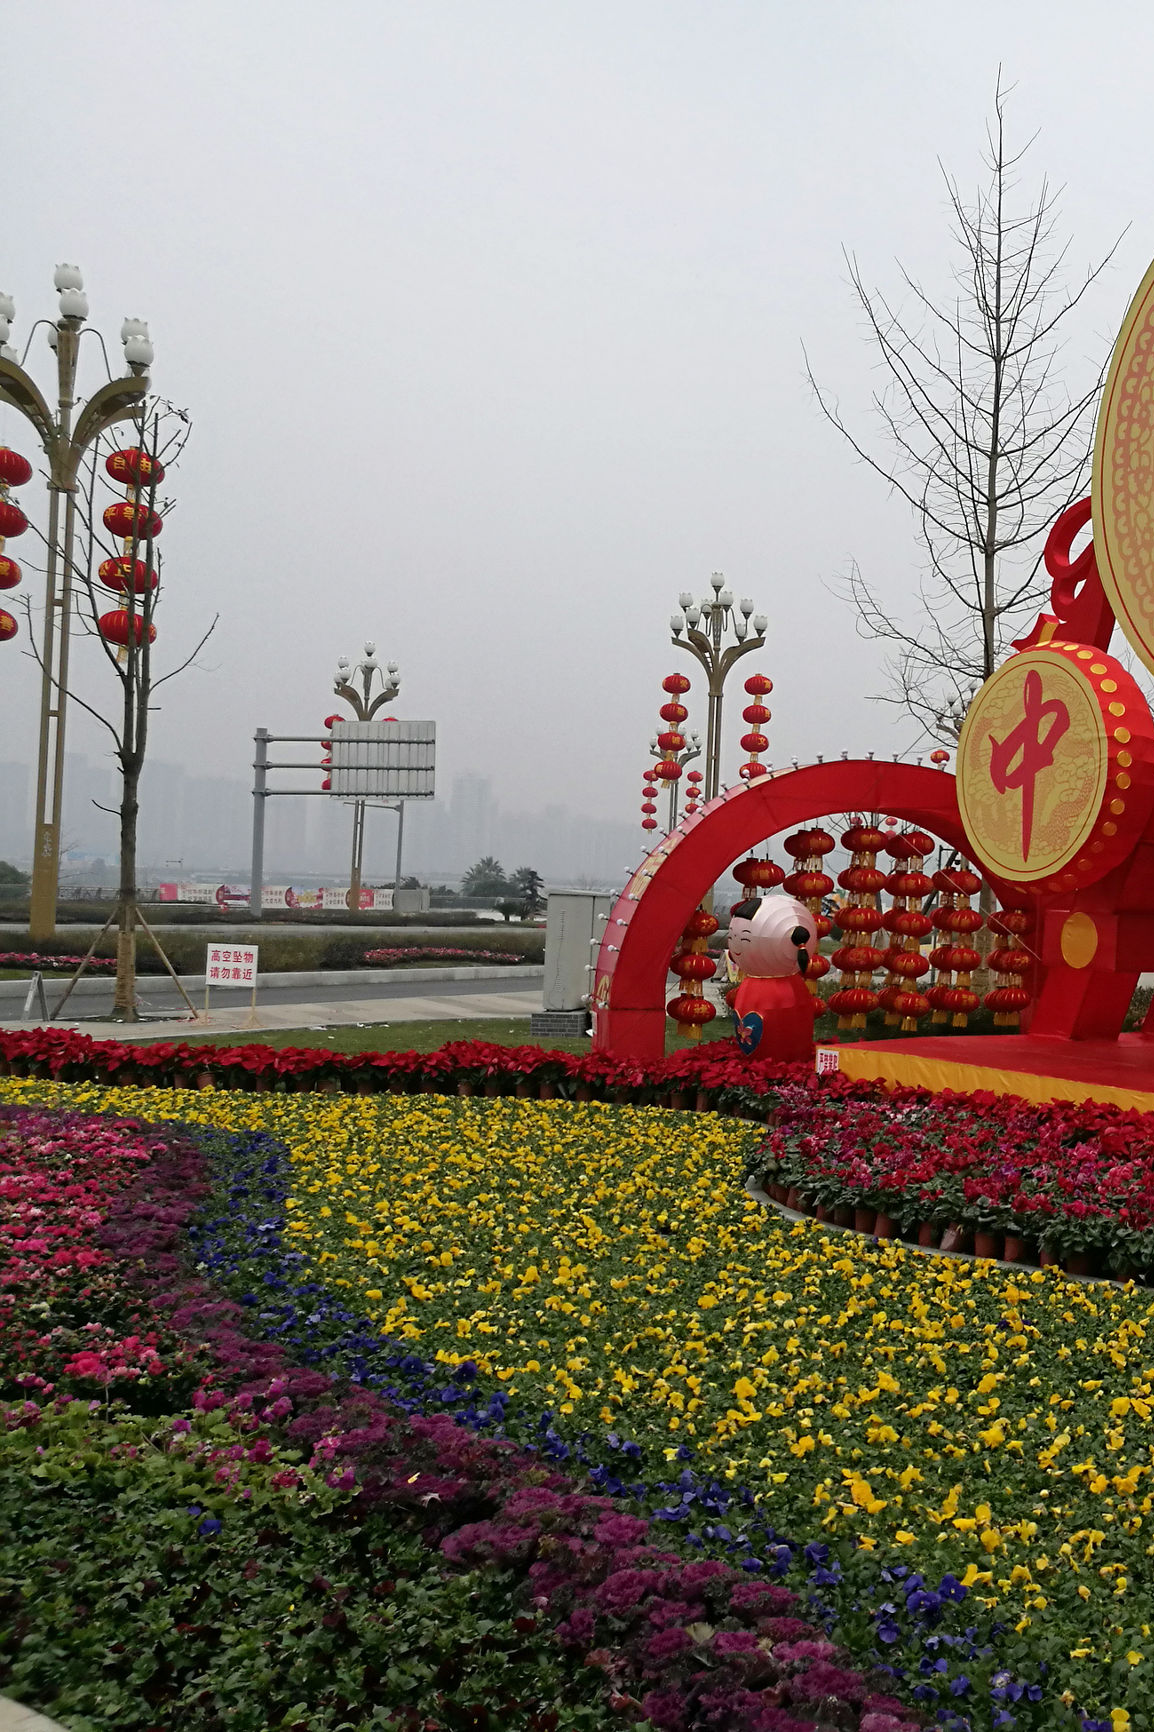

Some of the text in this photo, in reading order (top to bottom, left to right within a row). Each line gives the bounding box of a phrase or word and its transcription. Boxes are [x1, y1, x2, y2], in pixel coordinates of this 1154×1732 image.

[989, 669, 1070, 864] 中
[211, 950, 253, 963] 高空坠物
[210, 967, 252, 980] 请勿靠近
